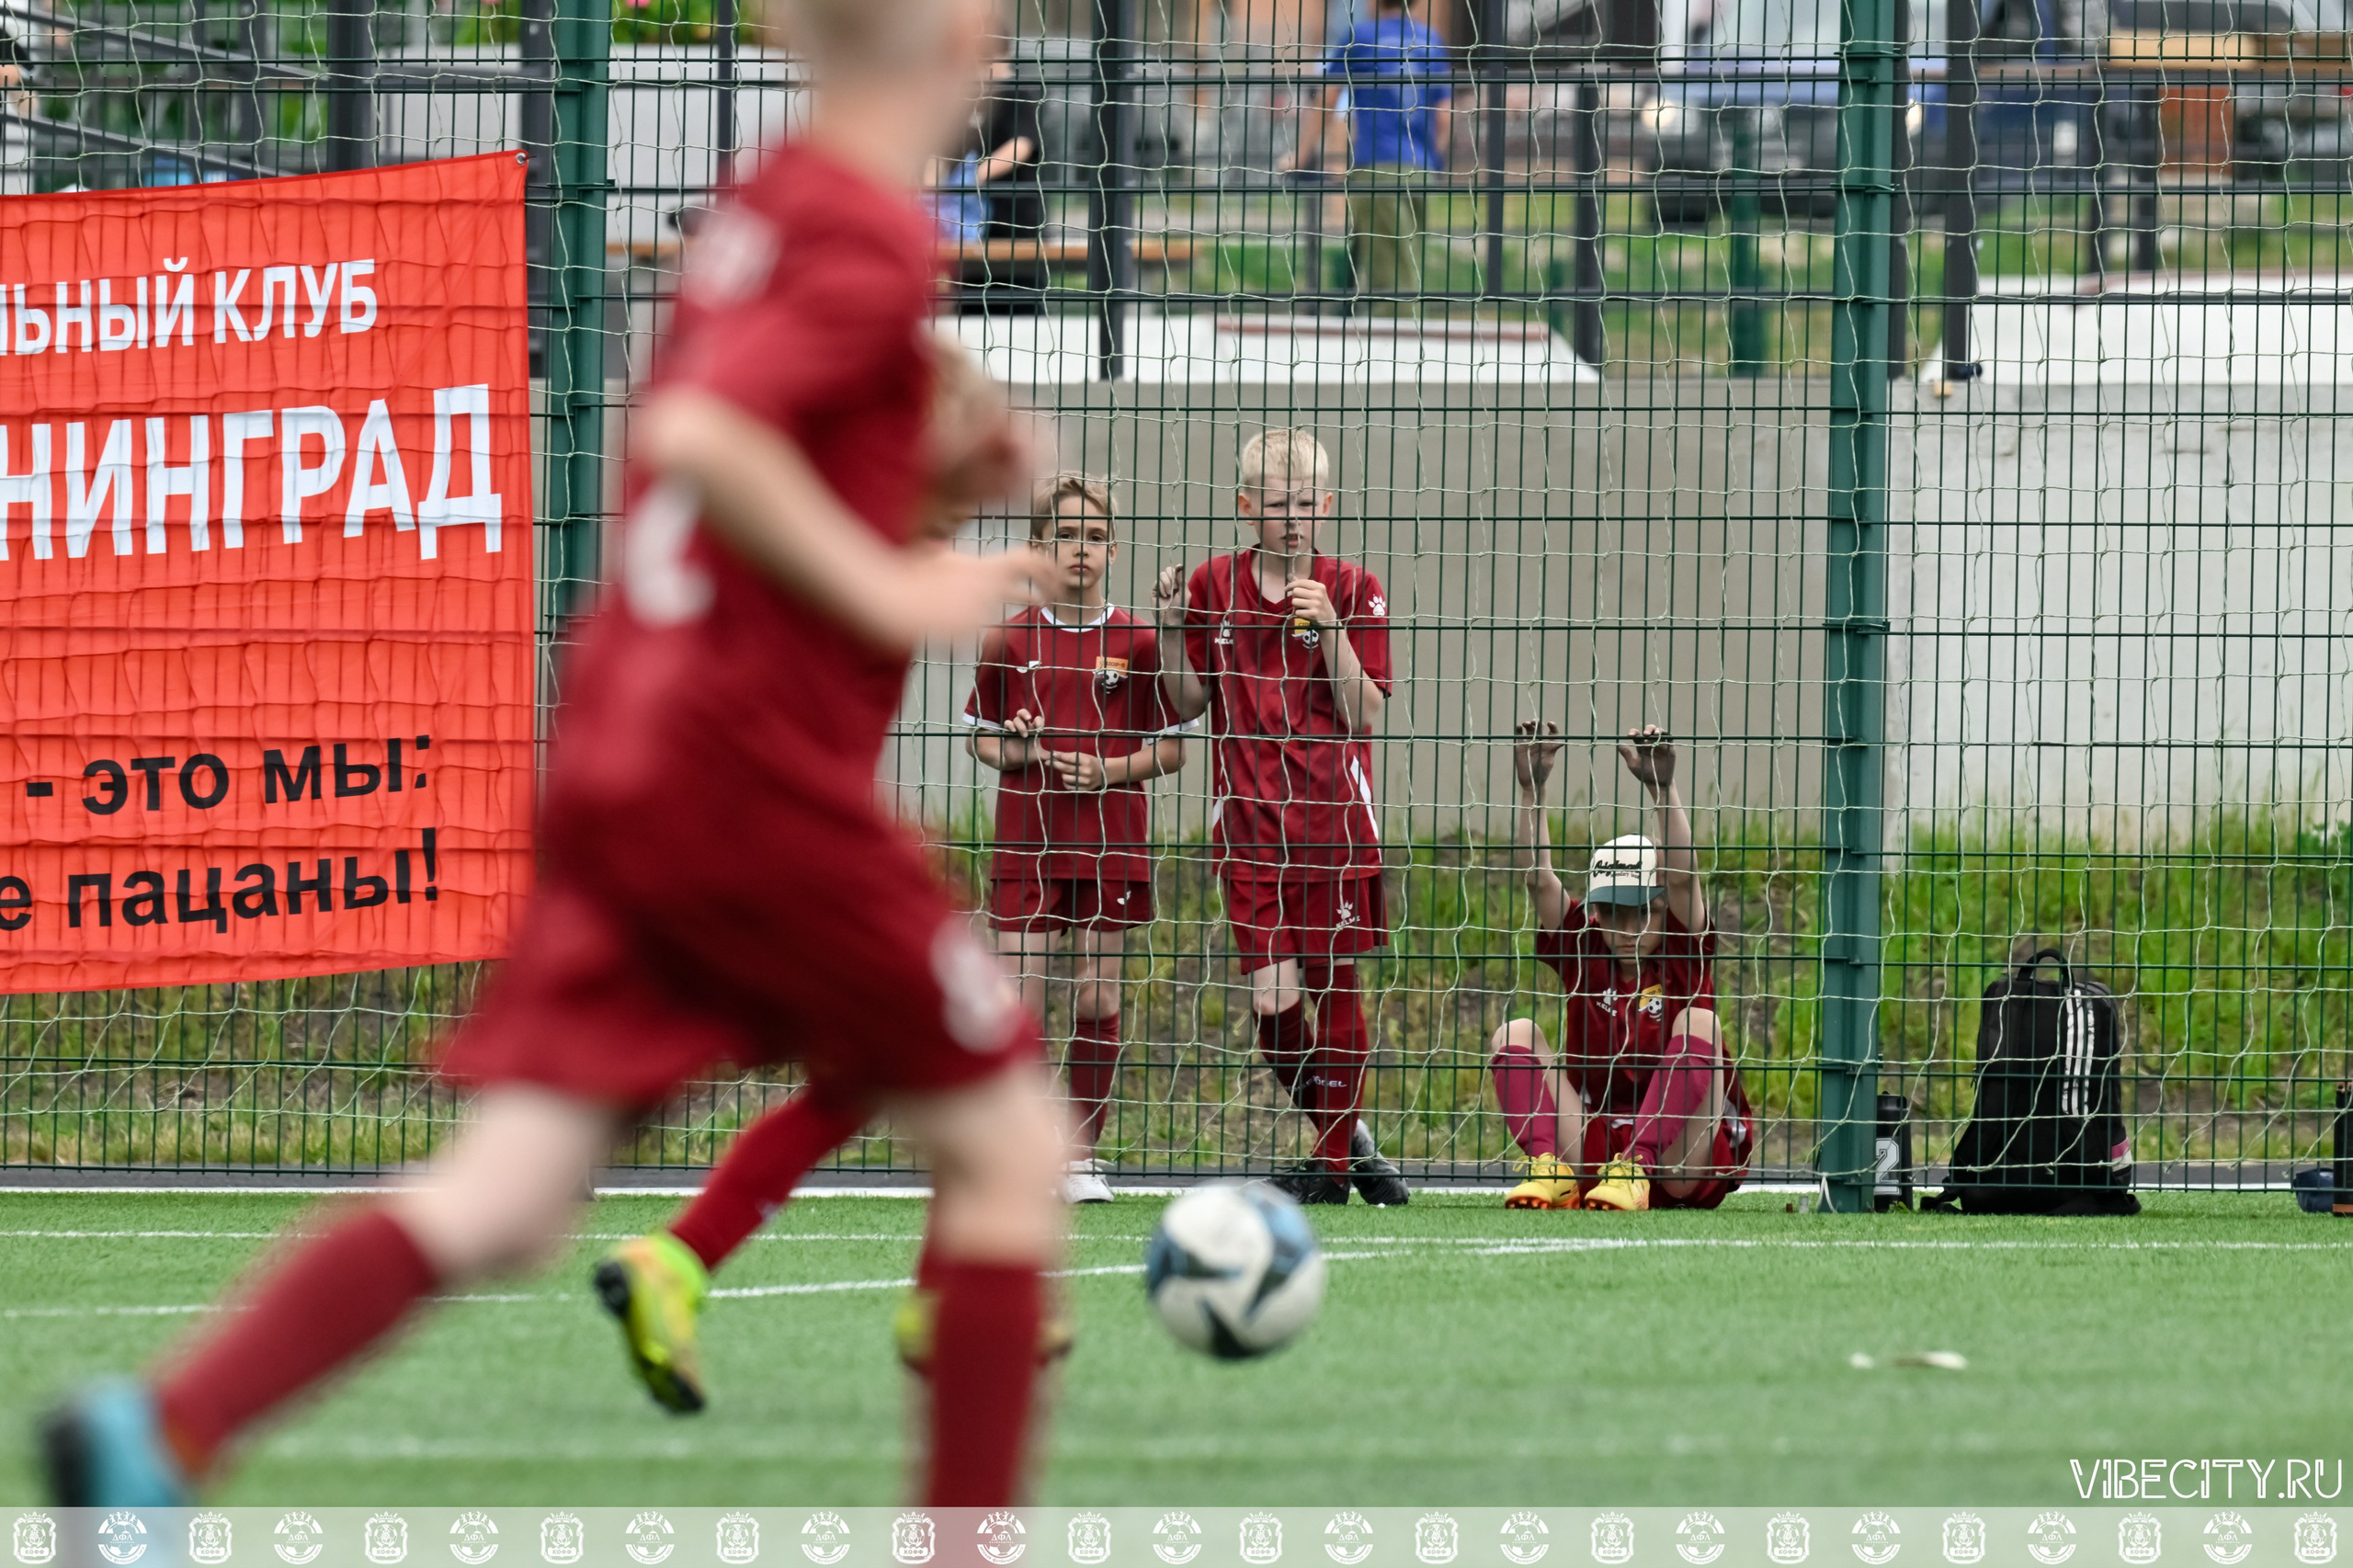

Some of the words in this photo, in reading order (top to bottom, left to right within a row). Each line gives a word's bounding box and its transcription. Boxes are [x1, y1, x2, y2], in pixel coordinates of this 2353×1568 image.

[213, 258, 378, 345] КЛУБ
[0, 383, 502, 561] НИНГРАД
[82, 752, 230, 815] это
[263, 734, 430, 804] мы:
[67, 826, 438, 934] пацаны!
